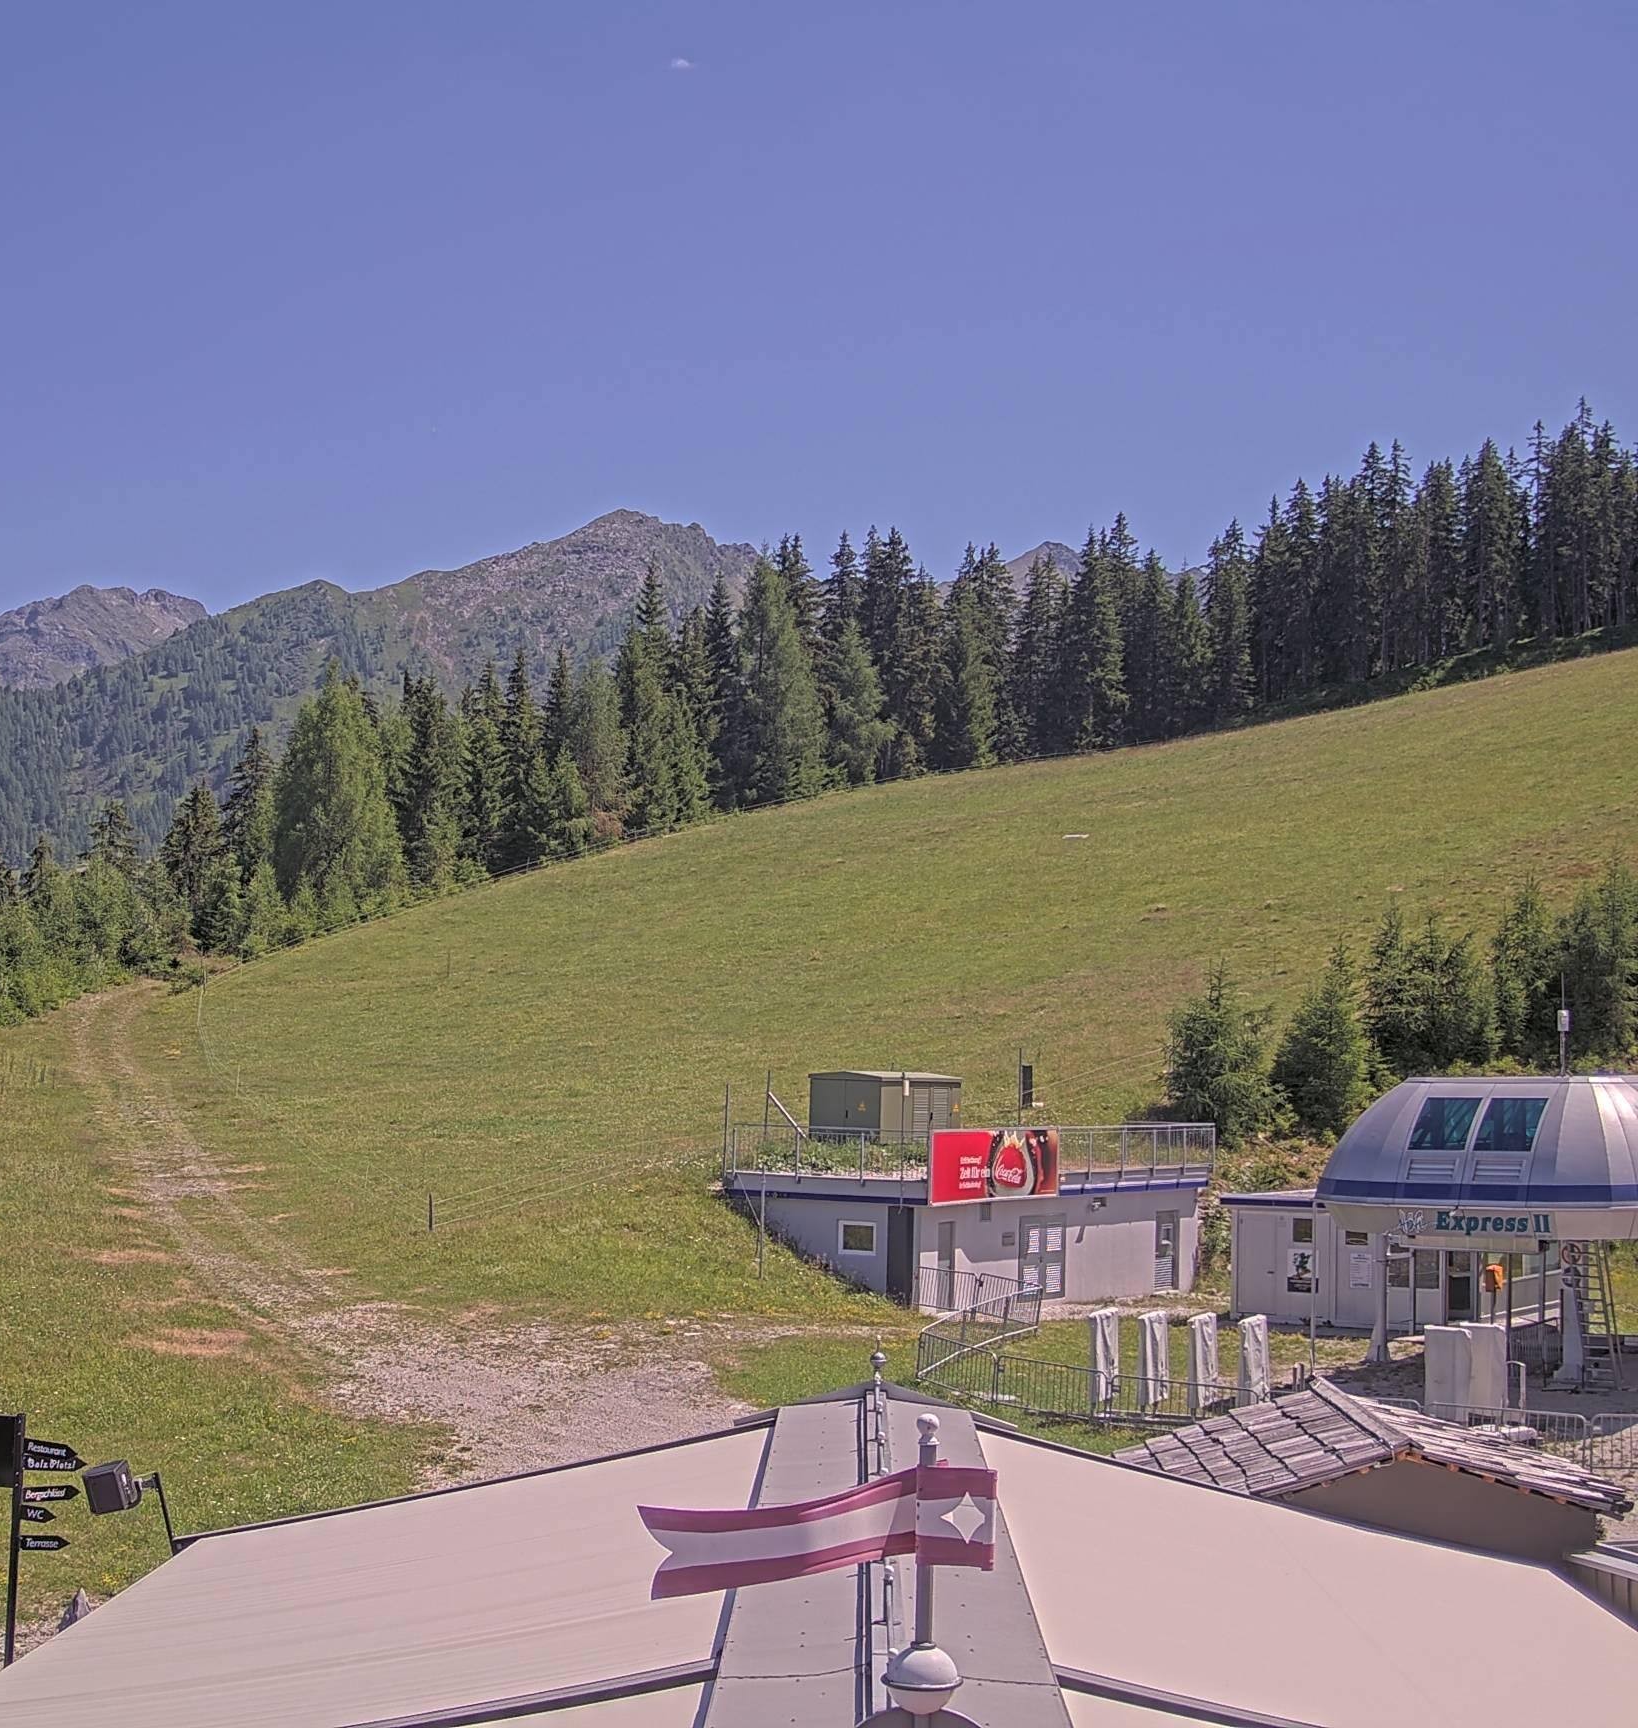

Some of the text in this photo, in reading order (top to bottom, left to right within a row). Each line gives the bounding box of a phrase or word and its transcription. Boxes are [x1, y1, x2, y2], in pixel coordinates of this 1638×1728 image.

[1435, 1211, 1529, 1236] Express
[27, 1442, 66, 1457] Restaurant
[27, 1508, 44, 1519] WC
[26, 1538, 59, 1549] Terrasse
